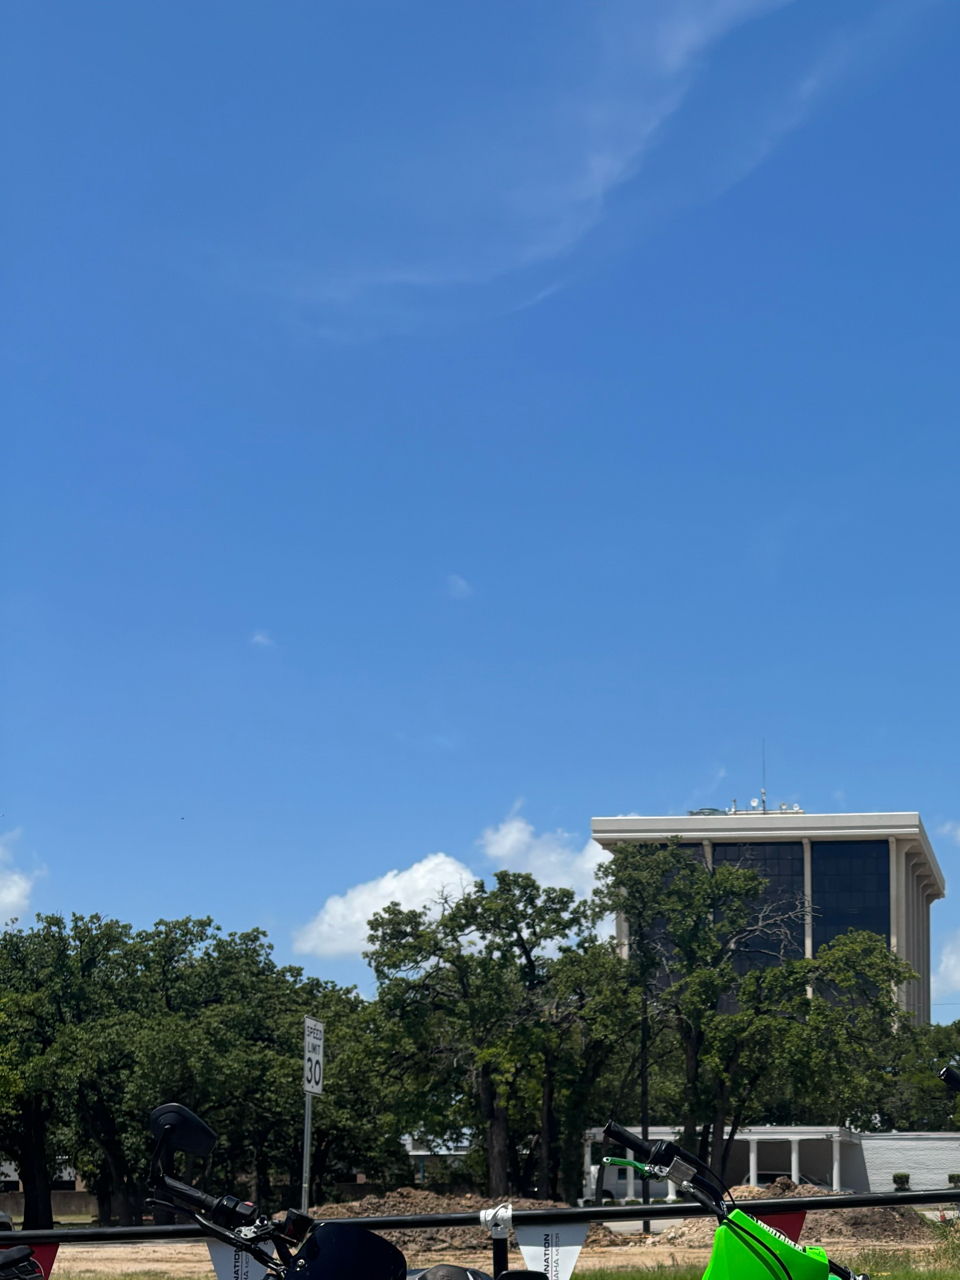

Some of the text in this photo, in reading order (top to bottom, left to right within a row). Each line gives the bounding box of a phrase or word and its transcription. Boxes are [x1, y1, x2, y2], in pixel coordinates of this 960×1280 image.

[306, 1025, 323, 1041] SPEED
[307, 1042, 321, 1055] LIMIT
[306, 1056, 322, 1086] 30
